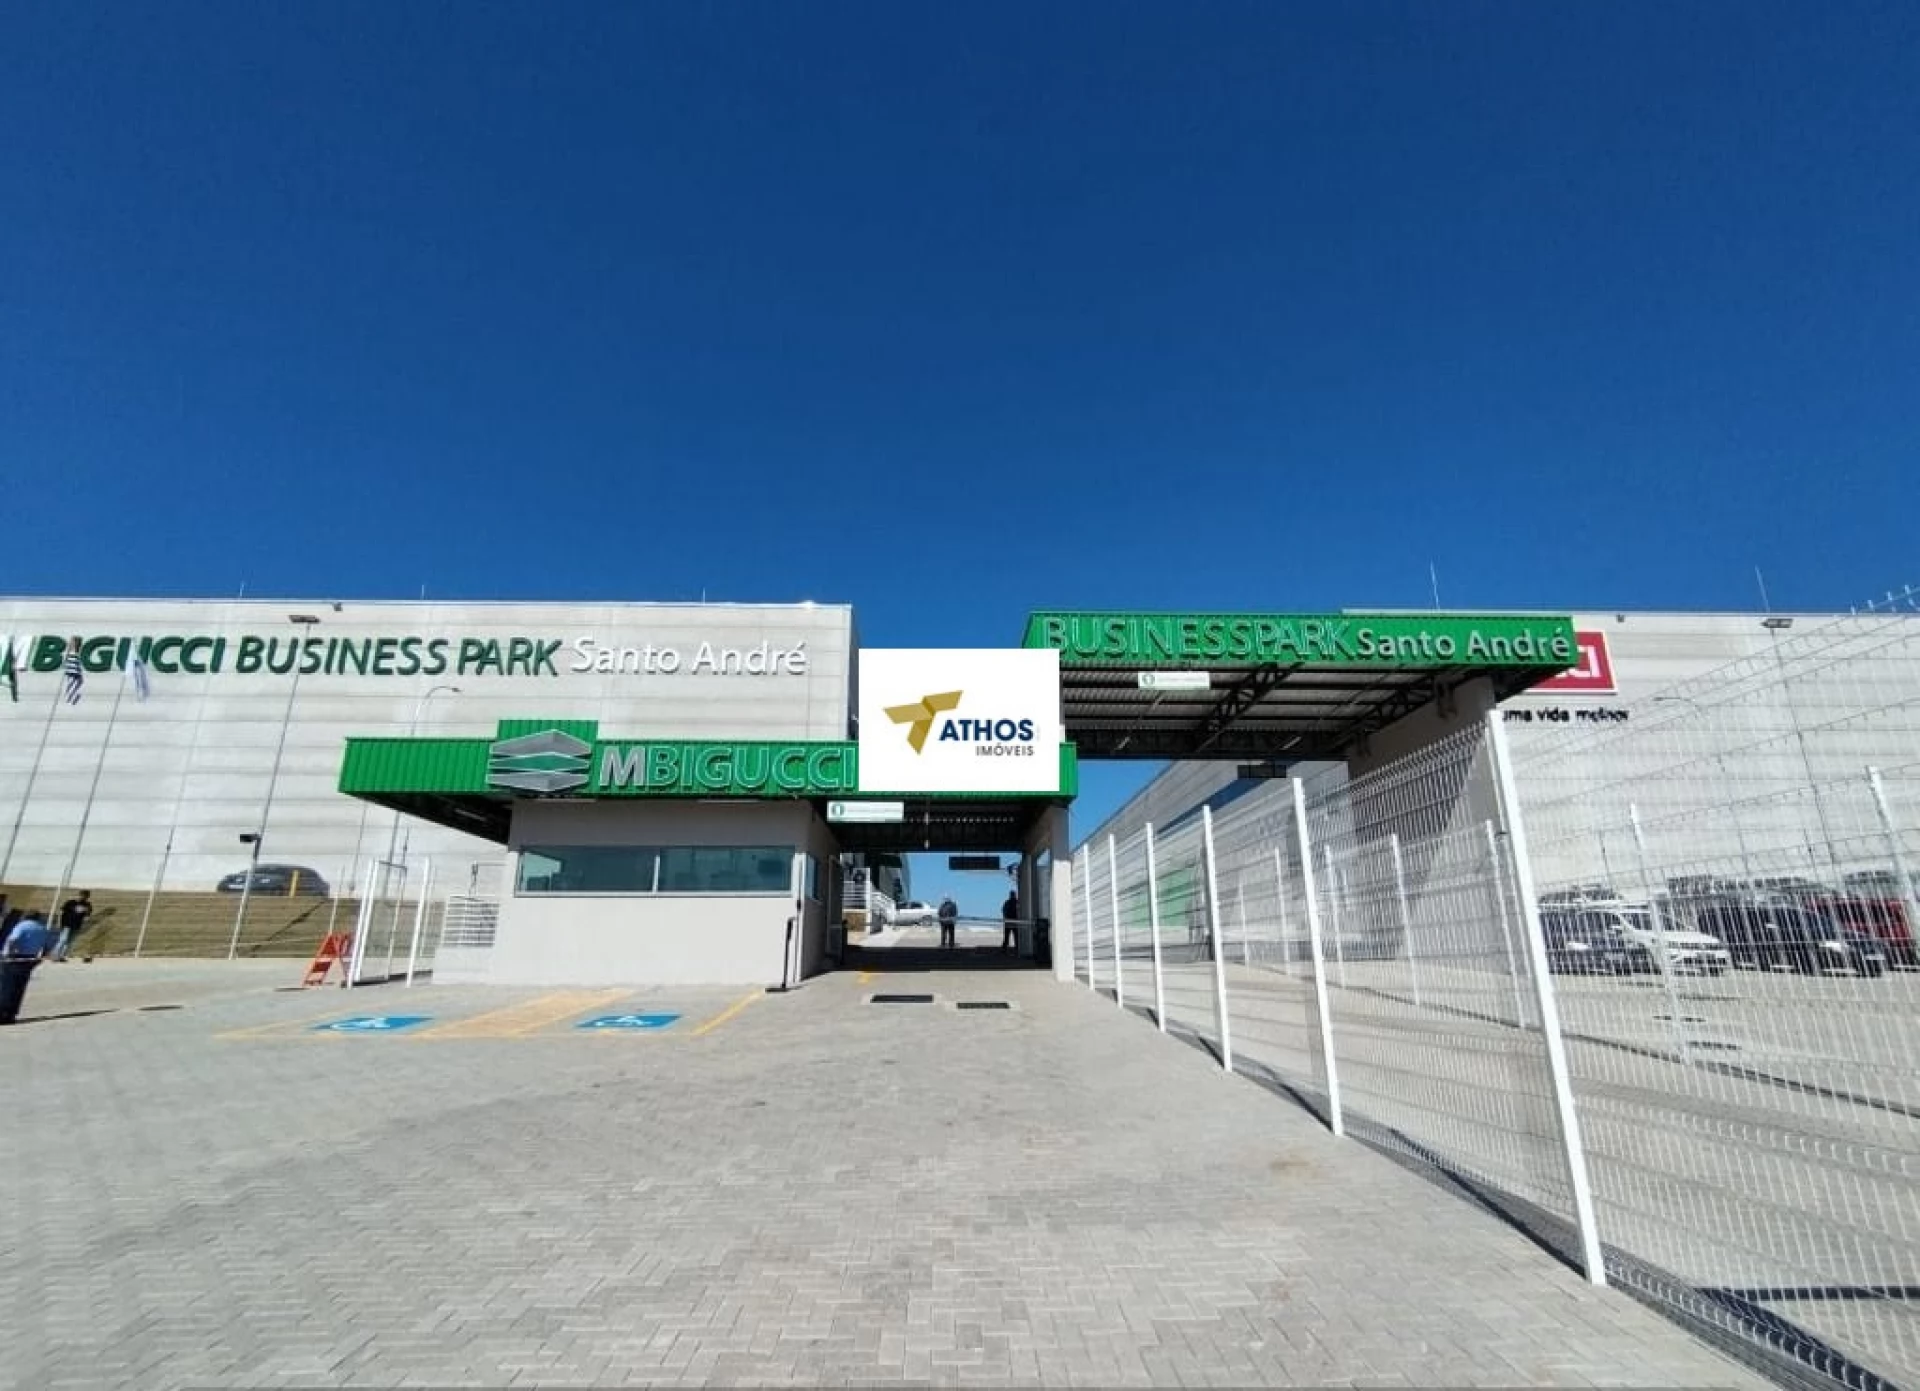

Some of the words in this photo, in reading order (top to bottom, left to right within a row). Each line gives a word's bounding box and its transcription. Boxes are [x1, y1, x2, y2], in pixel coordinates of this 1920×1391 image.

[236, 637, 448, 676] BUSINESS
[457, 637, 562, 677] PARK
[569, 638, 681, 675] Santo
[691, 639, 808, 676] André
[1356, 628, 1456, 658] Santo
[1466, 626, 1571, 659] André
[1536, 707, 1570, 722] vida
[599, 745, 857, 790] MBIGUCCI
